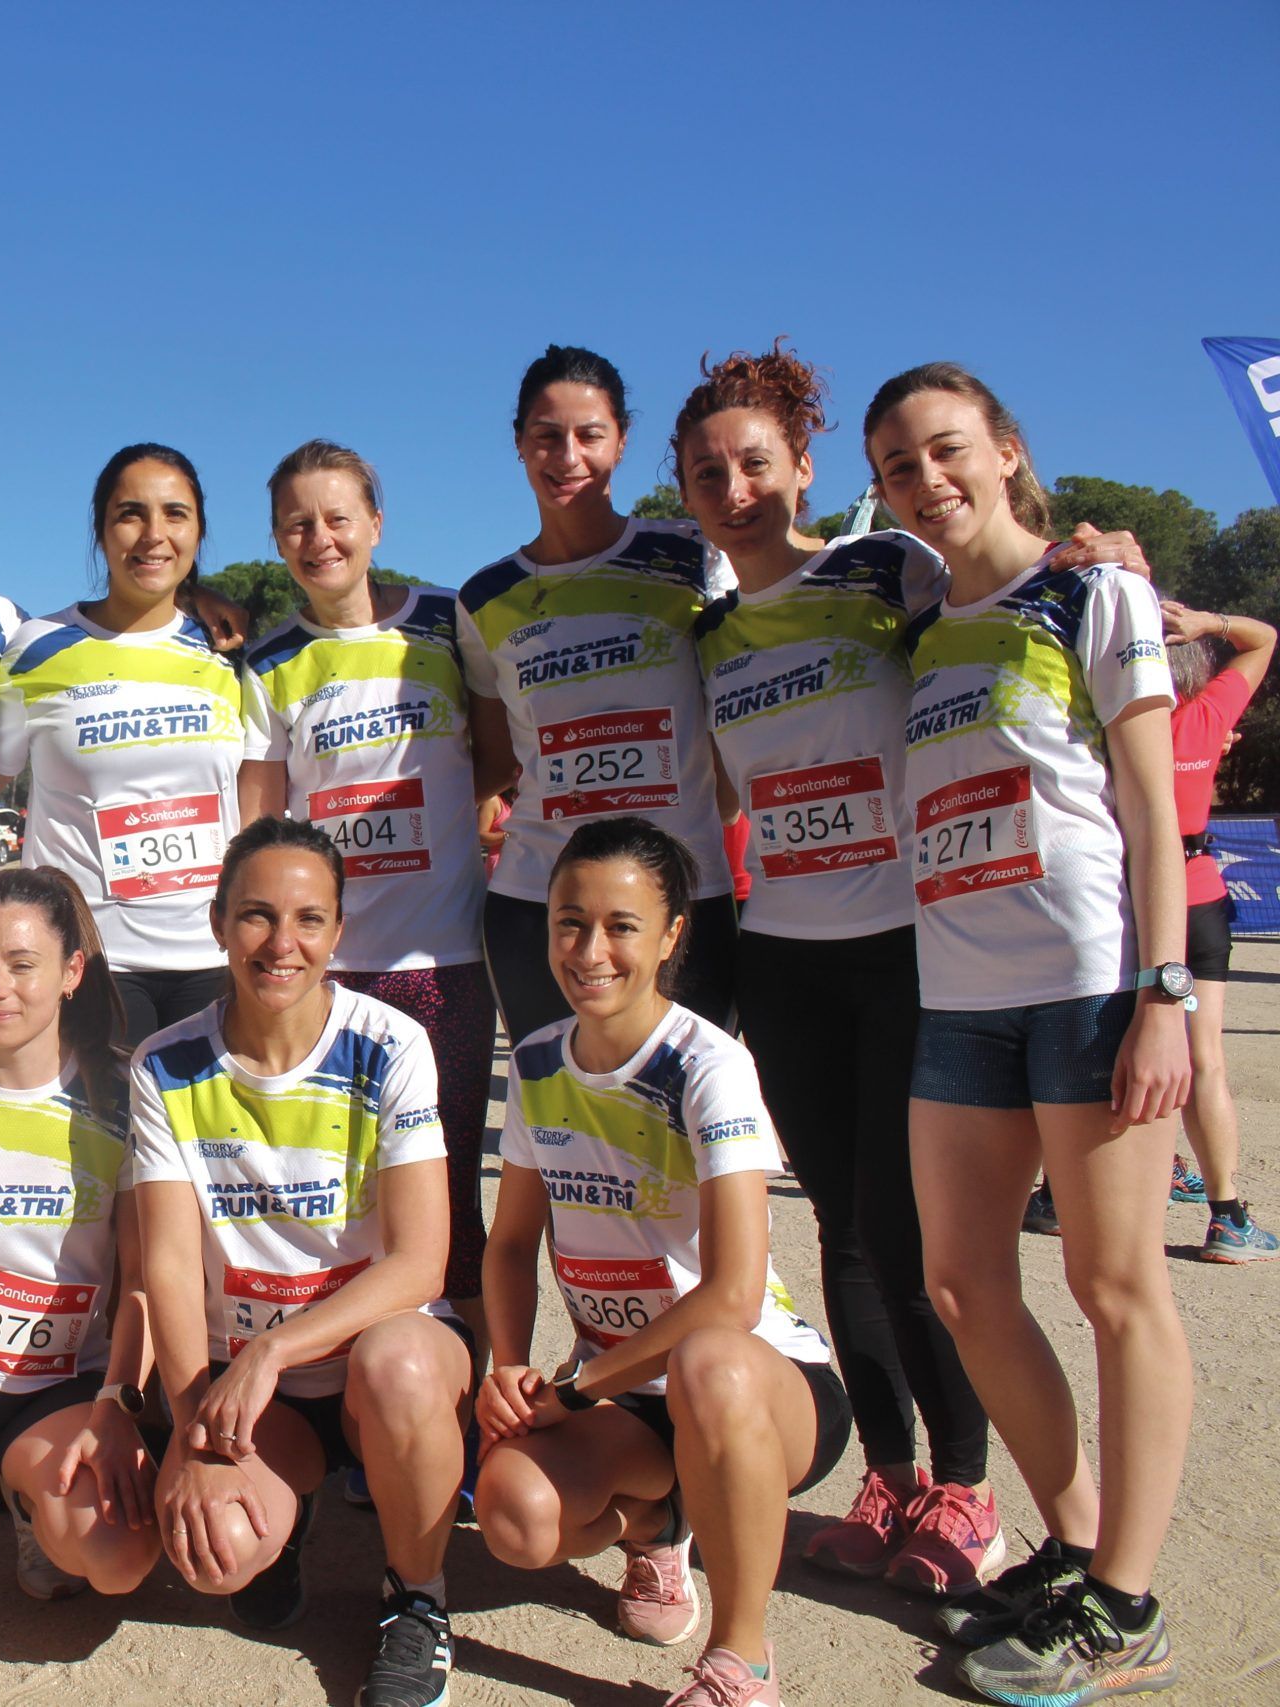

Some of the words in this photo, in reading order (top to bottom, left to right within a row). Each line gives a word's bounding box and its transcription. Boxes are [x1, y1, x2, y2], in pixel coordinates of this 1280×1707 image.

[515, 632, 641, 670] MARAZUELA
[65, 684, 108, 698] VICTORY
[714, 657, 831, 707] MARAZUELA
[75, 703, 212, 726] MARAZUELA
[311, 700, 431, 734] MARAZUELA
[578, 722, 645, 740] Santander
[574, 747, 645, 786] 252
[1174, 759, 1212, 772] tander
[787, 775, 852, 796] Santander
[337, 791, 397, 808] Santander
[940, 785, 1001, 812] Santander
[140, 806, 199, 824] Santander
[784, 802, 855, 844] 354
[333, 815, 397, 850] 404
[936, 816, 992, 865] 271
[140, 831, 197, 867] 361
[206, 1177, 341, 1195] MARAZUELA
[269, 1278, 344, 1297] Santander
[574, 1268, 640, 1283] Santander
[581, 1293, 650, 1330] 366
